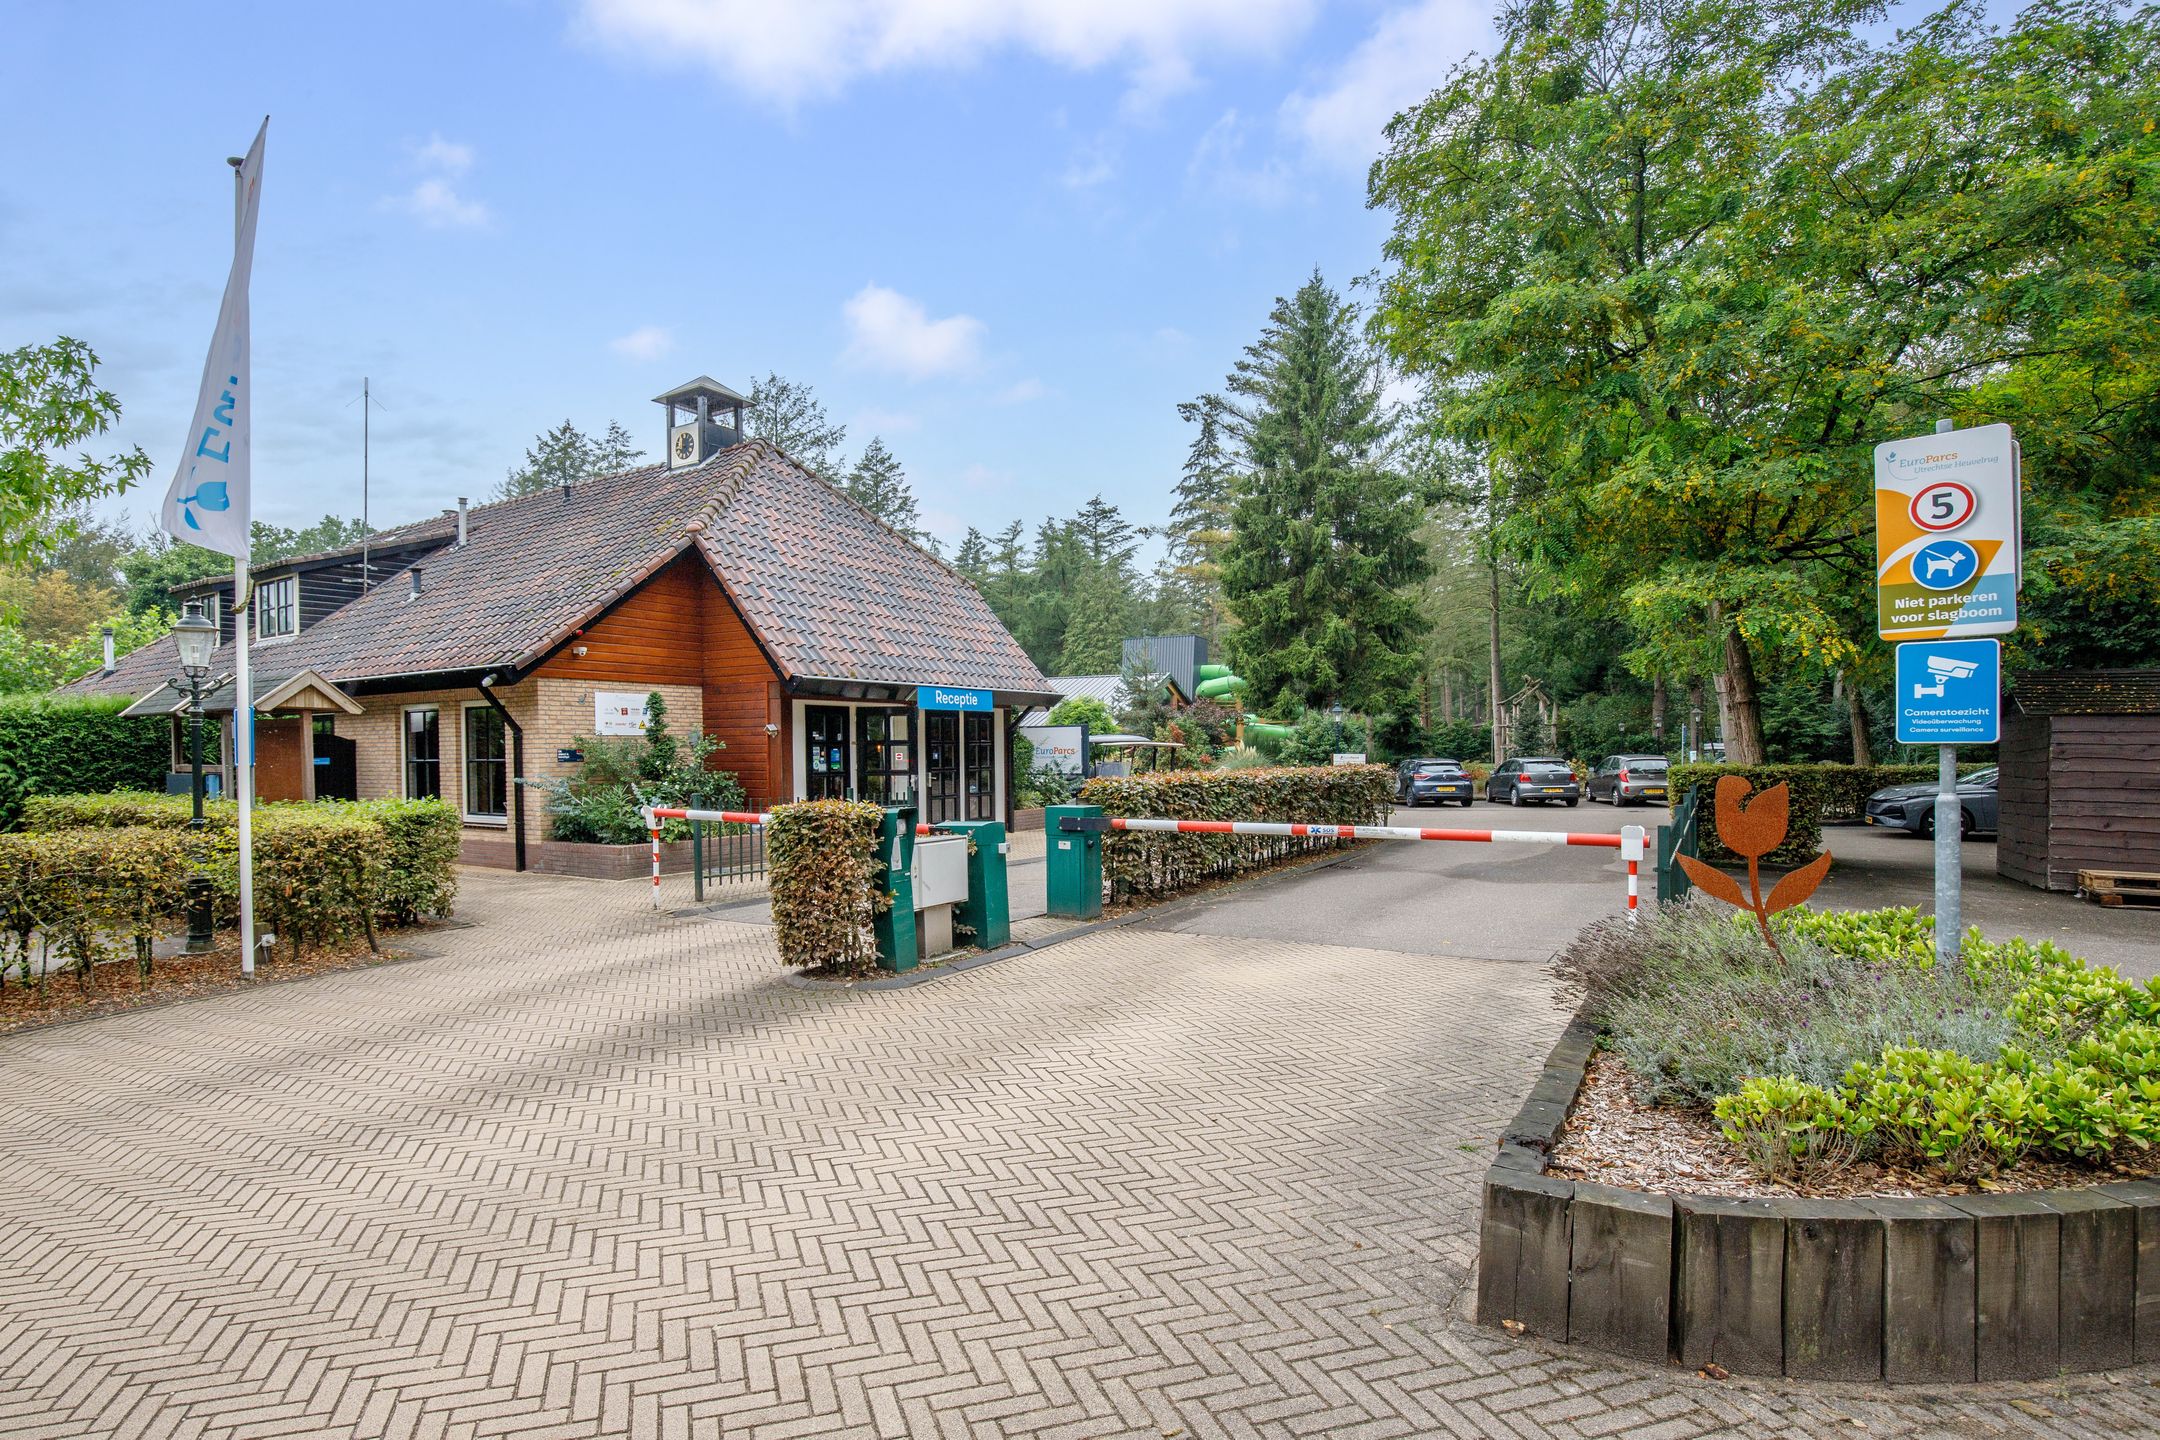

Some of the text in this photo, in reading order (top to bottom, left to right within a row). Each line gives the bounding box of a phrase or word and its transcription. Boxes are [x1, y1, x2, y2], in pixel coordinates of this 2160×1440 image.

[1900, 452, 1958, 468] EuroParcs
[1914, 455, 1999, 474] Utrechtse Heuvelrug
[1931, 492, 1954, 519] 5
[1895, 592, 1998, 609] Niet parkeren
[1891, 607, 2002, 623] voor slagboom
[935, 689, 978, 709] Receptie
[1904, 708, 1990, 717] Cameratoezicht
[1035, 746, 1076, 755] EuroParcs
